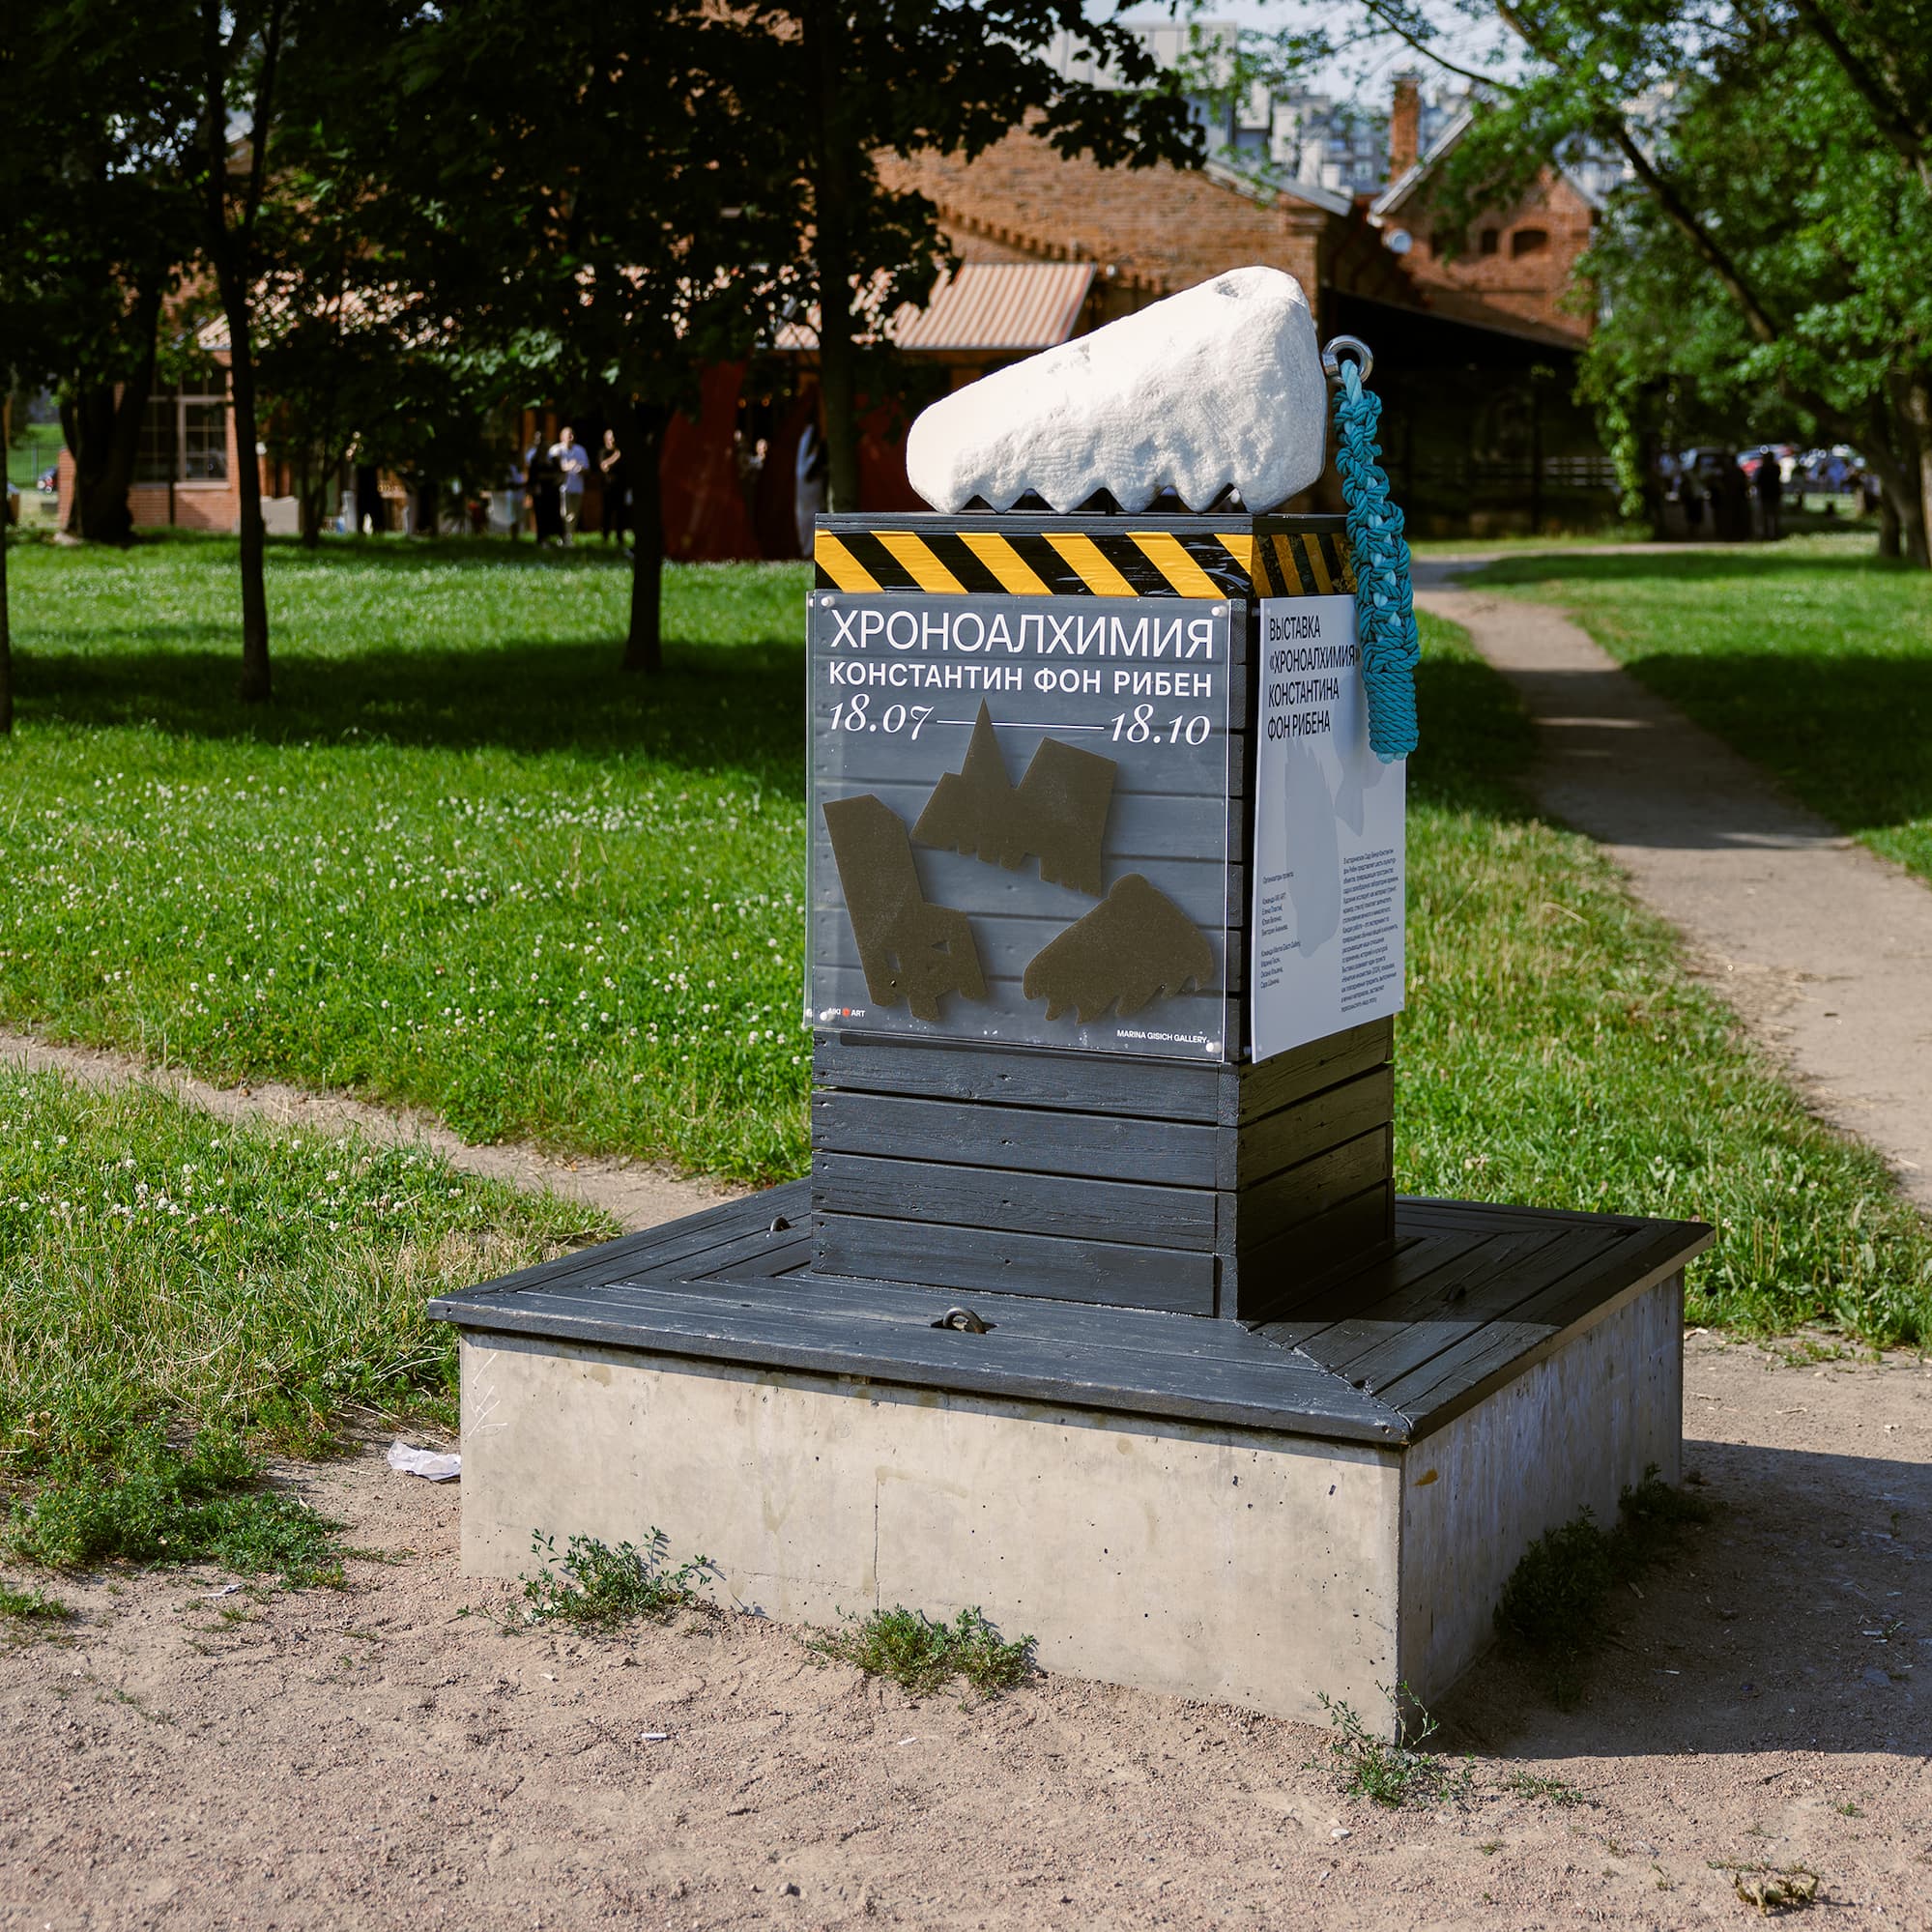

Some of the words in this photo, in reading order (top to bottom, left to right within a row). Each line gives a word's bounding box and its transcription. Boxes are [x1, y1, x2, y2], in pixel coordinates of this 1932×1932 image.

[830, 609, 1213, 659] ХРОНОАЛХИМИЯ
[1269, 615, 1321, 642] ВЫСТАВКА
[829, 661, 1023, 691] КОНСТАНТИН
[1033, 667, 1101, 694] ФОН
[1113, 670, 1212, 698] РИБЕН
[1268, 678, 1340, 708] КОНСТАНТИНА
[829, 693, 935, 740] 18.07
[1110, 703, 1211, 746] 18.10
[1267, 714, 1290, 741] ФОН
[1292, 709, 1331, 737] РИБЕНА
[851, 1009, 866, 1018] ART
[1116, 1029, 1146, 1039] MARINA
[1146, 1031, 1173, 1041] GISICH
[1173, 1033, 1207, 1044] GALLERY
